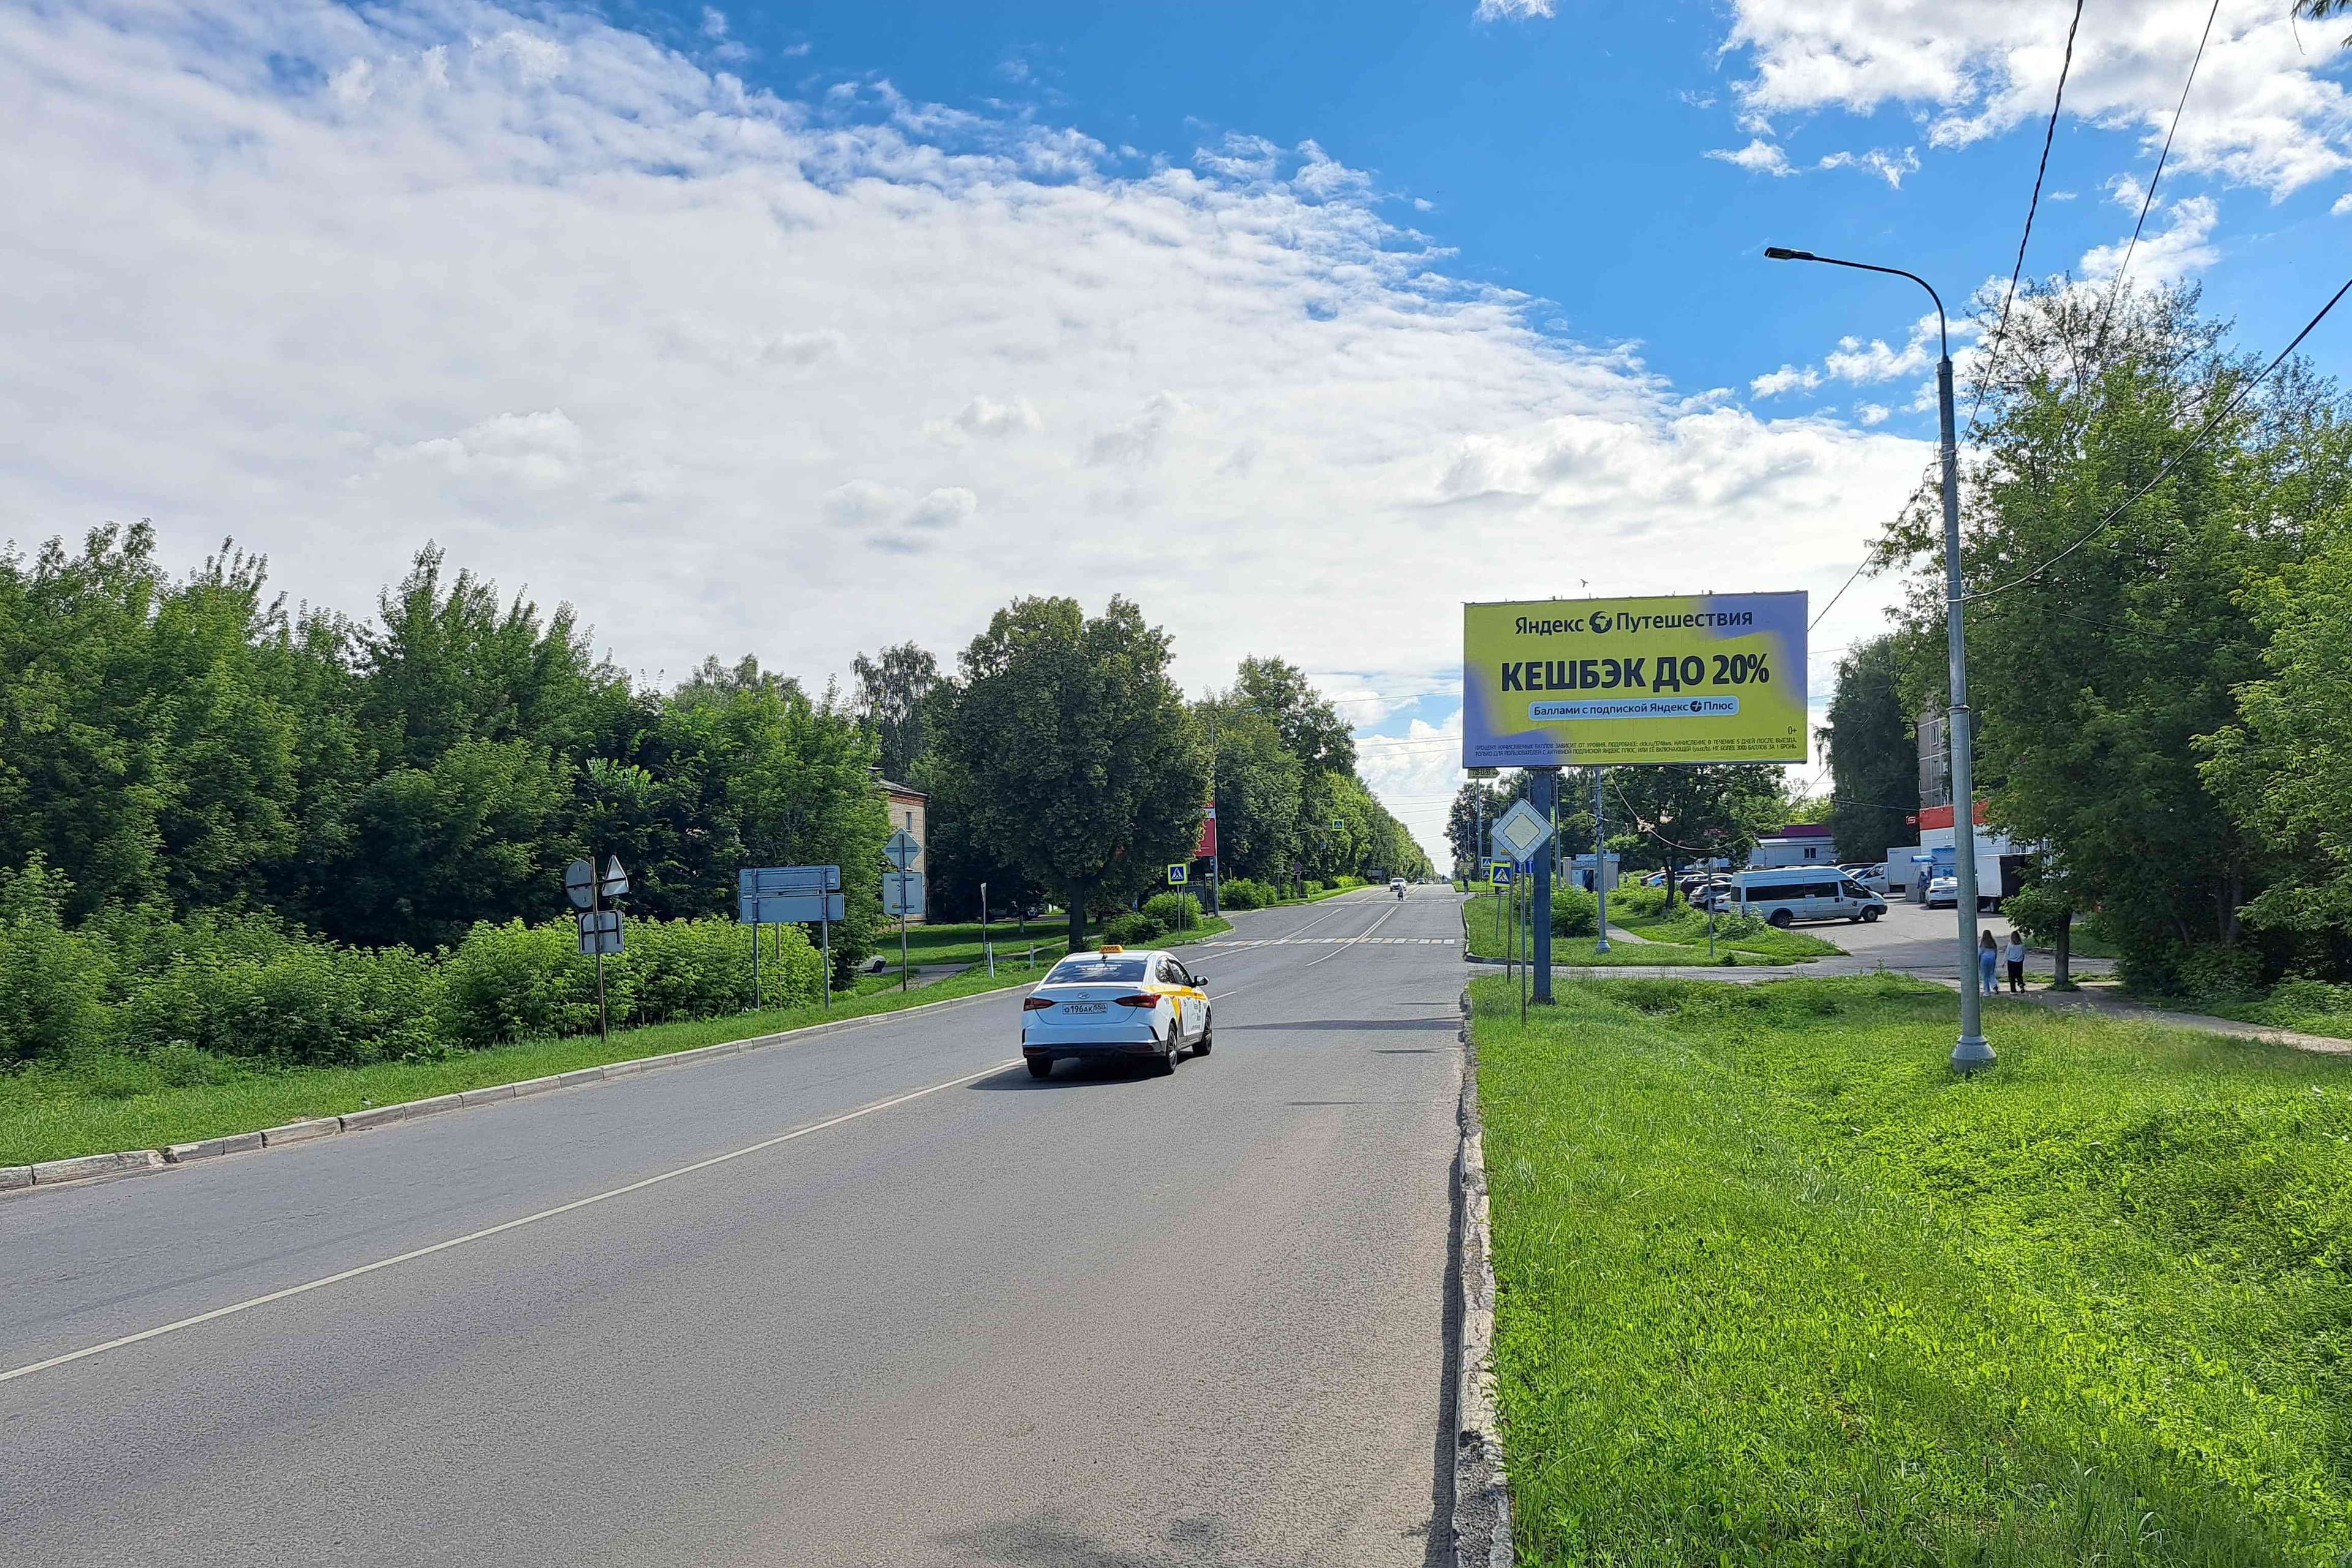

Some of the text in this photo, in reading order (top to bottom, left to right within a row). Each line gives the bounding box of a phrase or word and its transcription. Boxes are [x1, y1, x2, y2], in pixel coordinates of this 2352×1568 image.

[1515, 611, 1753, 636] Яндекс Путешествия
[1501, 653, 1770, 693] КЕШБЭК ДО 20%
[1534, 706, 1580, 715] Баллами
[1590, 704, 1647, 715] подпиской
[1649, 703, 1689, 713] Яндекс
[1703, 701, 1734, 710] Плюс
[1787, 725, 1798, 735] 0+
